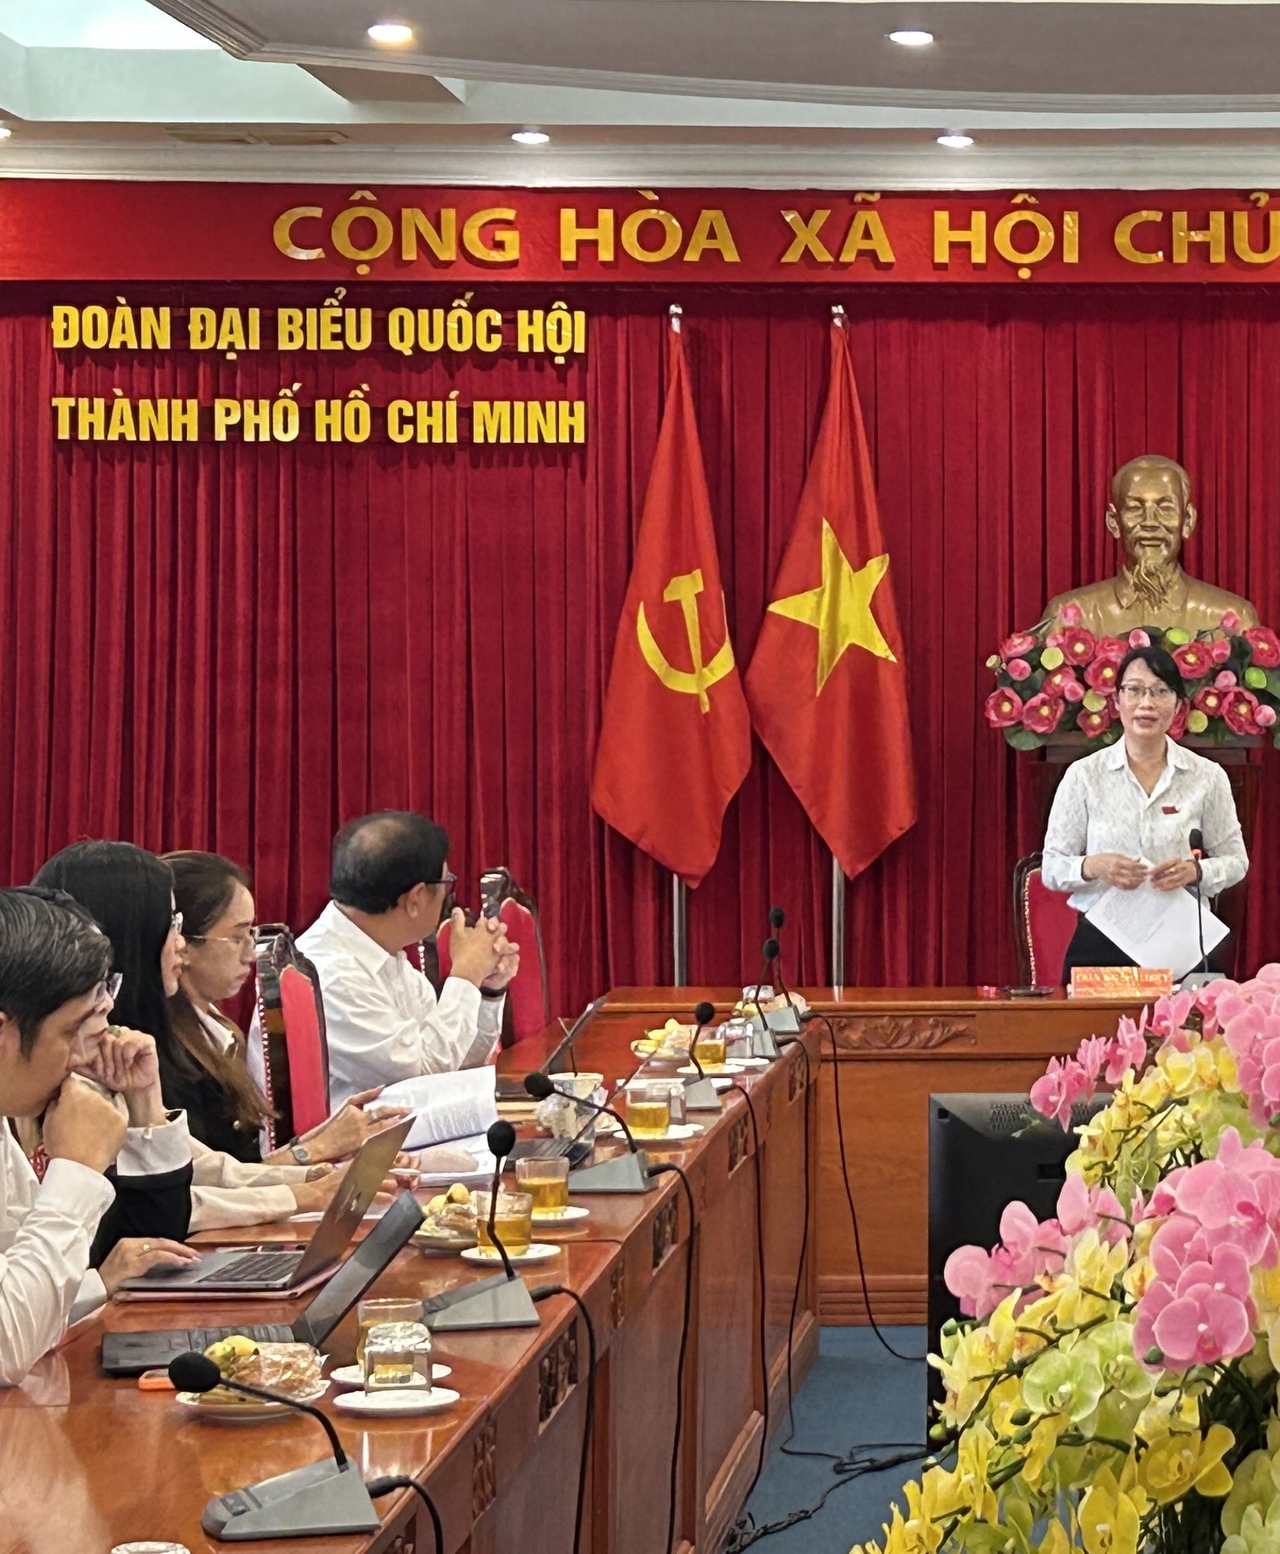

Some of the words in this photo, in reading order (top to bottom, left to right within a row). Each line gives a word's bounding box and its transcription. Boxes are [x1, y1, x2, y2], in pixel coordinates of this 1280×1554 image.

[273, 190, 520, 275] CỘNG
[560, 188, 740, 263] HÒA
[781, 192, 895, 263] XÃ
[933, 193, 1079, 280] HỘI
[51, 296, 171, 350] ĐOÀN
[187, 307, 261, 360] ĐẠI
[277, 286, 372, 351] BIỂU
[388, 291, 503, 356] QUỐC
[517, 300, 586, 364] HỘI
[51, 388, 199, 442] THÀNH
[214, 383, 303, 443] PHỐ
[314, 384, 371, 443] HỒ
[387, 390, 460, 444] CHÍ
[472, 401, 585, 444] MINH
